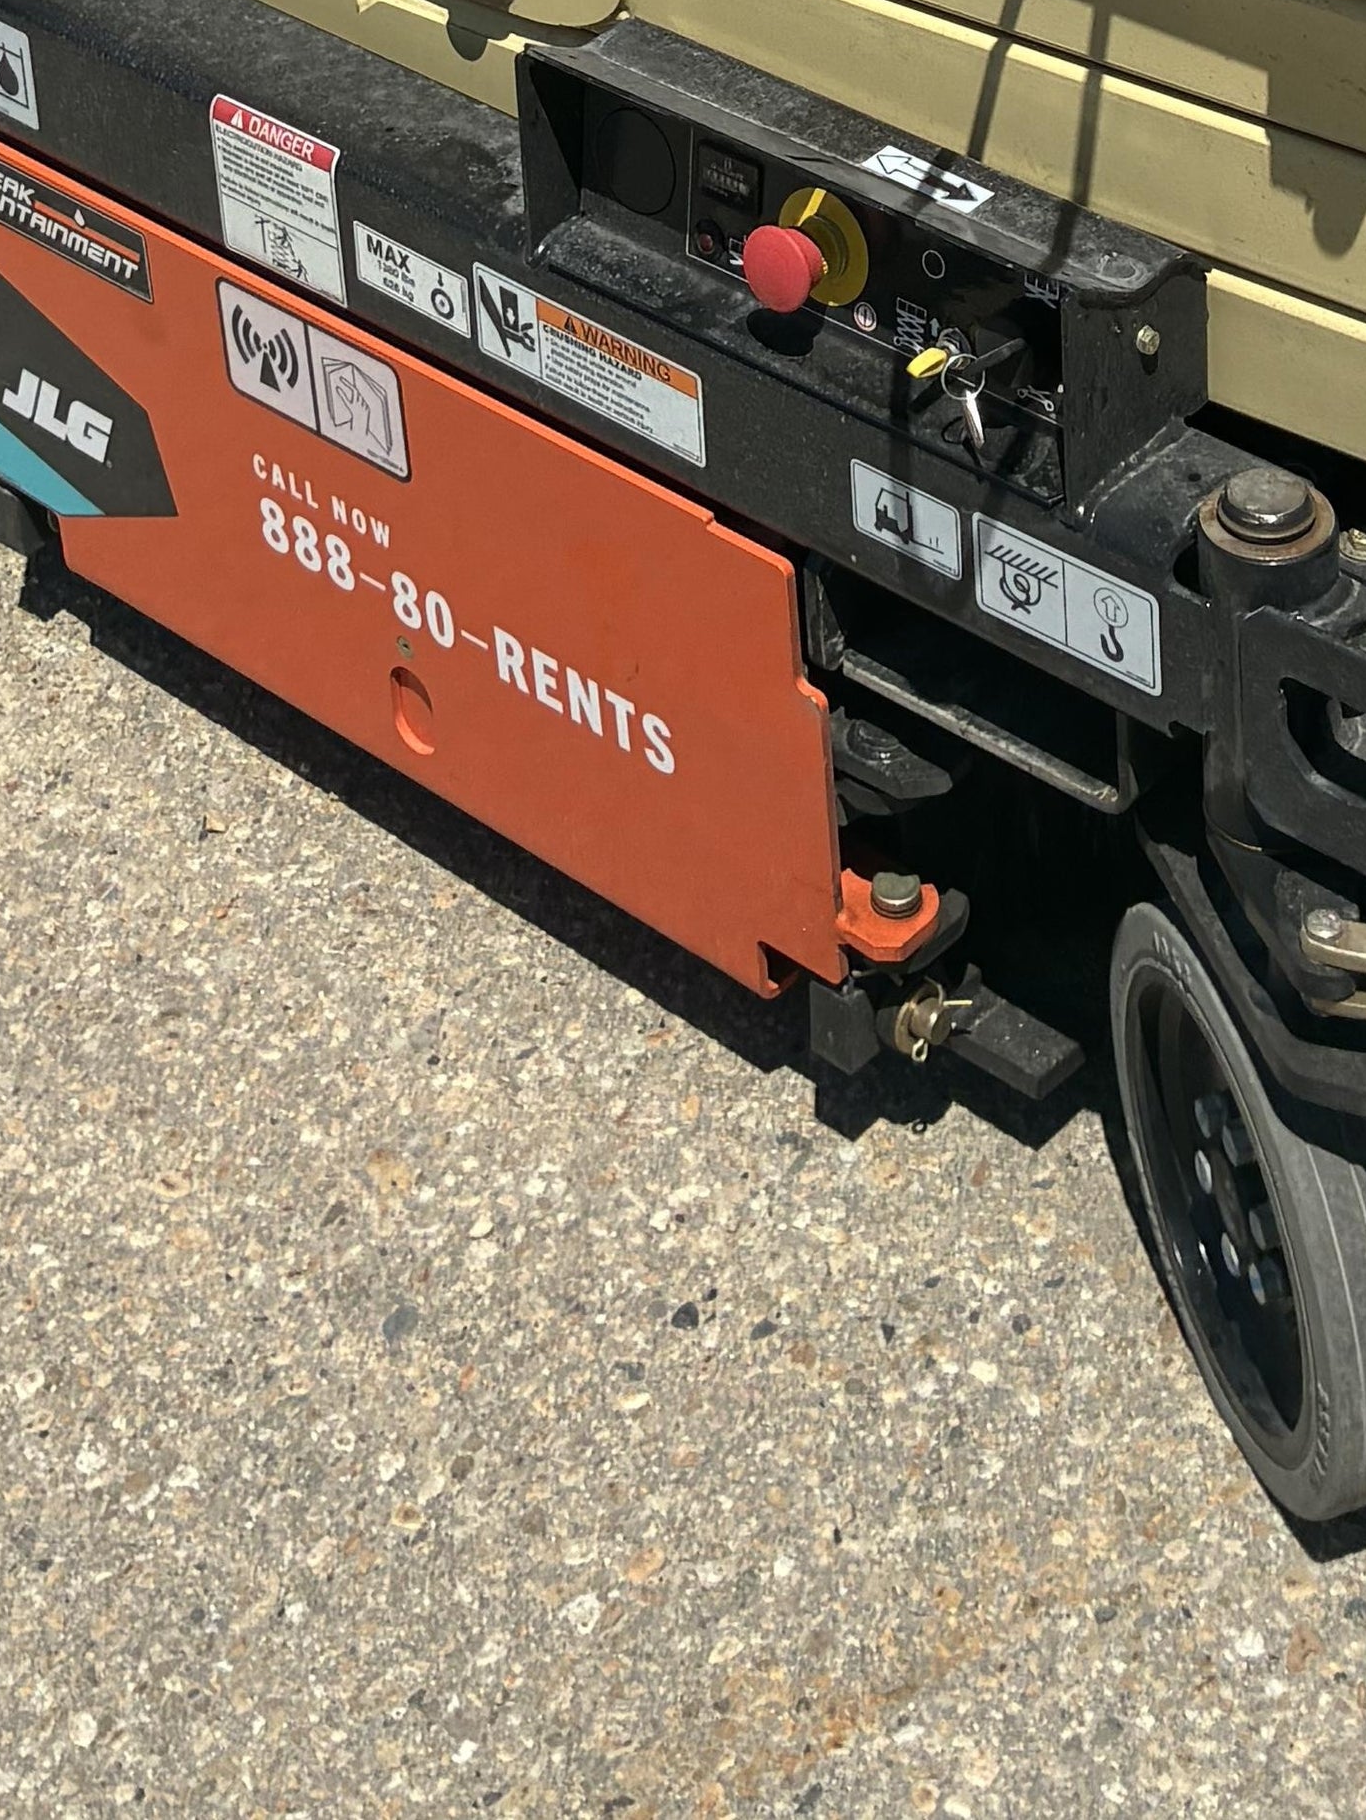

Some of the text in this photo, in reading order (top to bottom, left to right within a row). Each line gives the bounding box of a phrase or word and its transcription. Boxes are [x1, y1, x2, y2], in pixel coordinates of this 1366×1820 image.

[248, 116, 315, 162] DANGER
[366, 233, 411, 275] MAX
[543, 324, 643, 382] CRUSHING HAZARD
[580, 321, 672, 383] WARNING
[2, 368, 113, 463] JLG
[253, 453, 391, 549] CALL NOW
[259, 497, 676, 775] 888-80-RENTS
